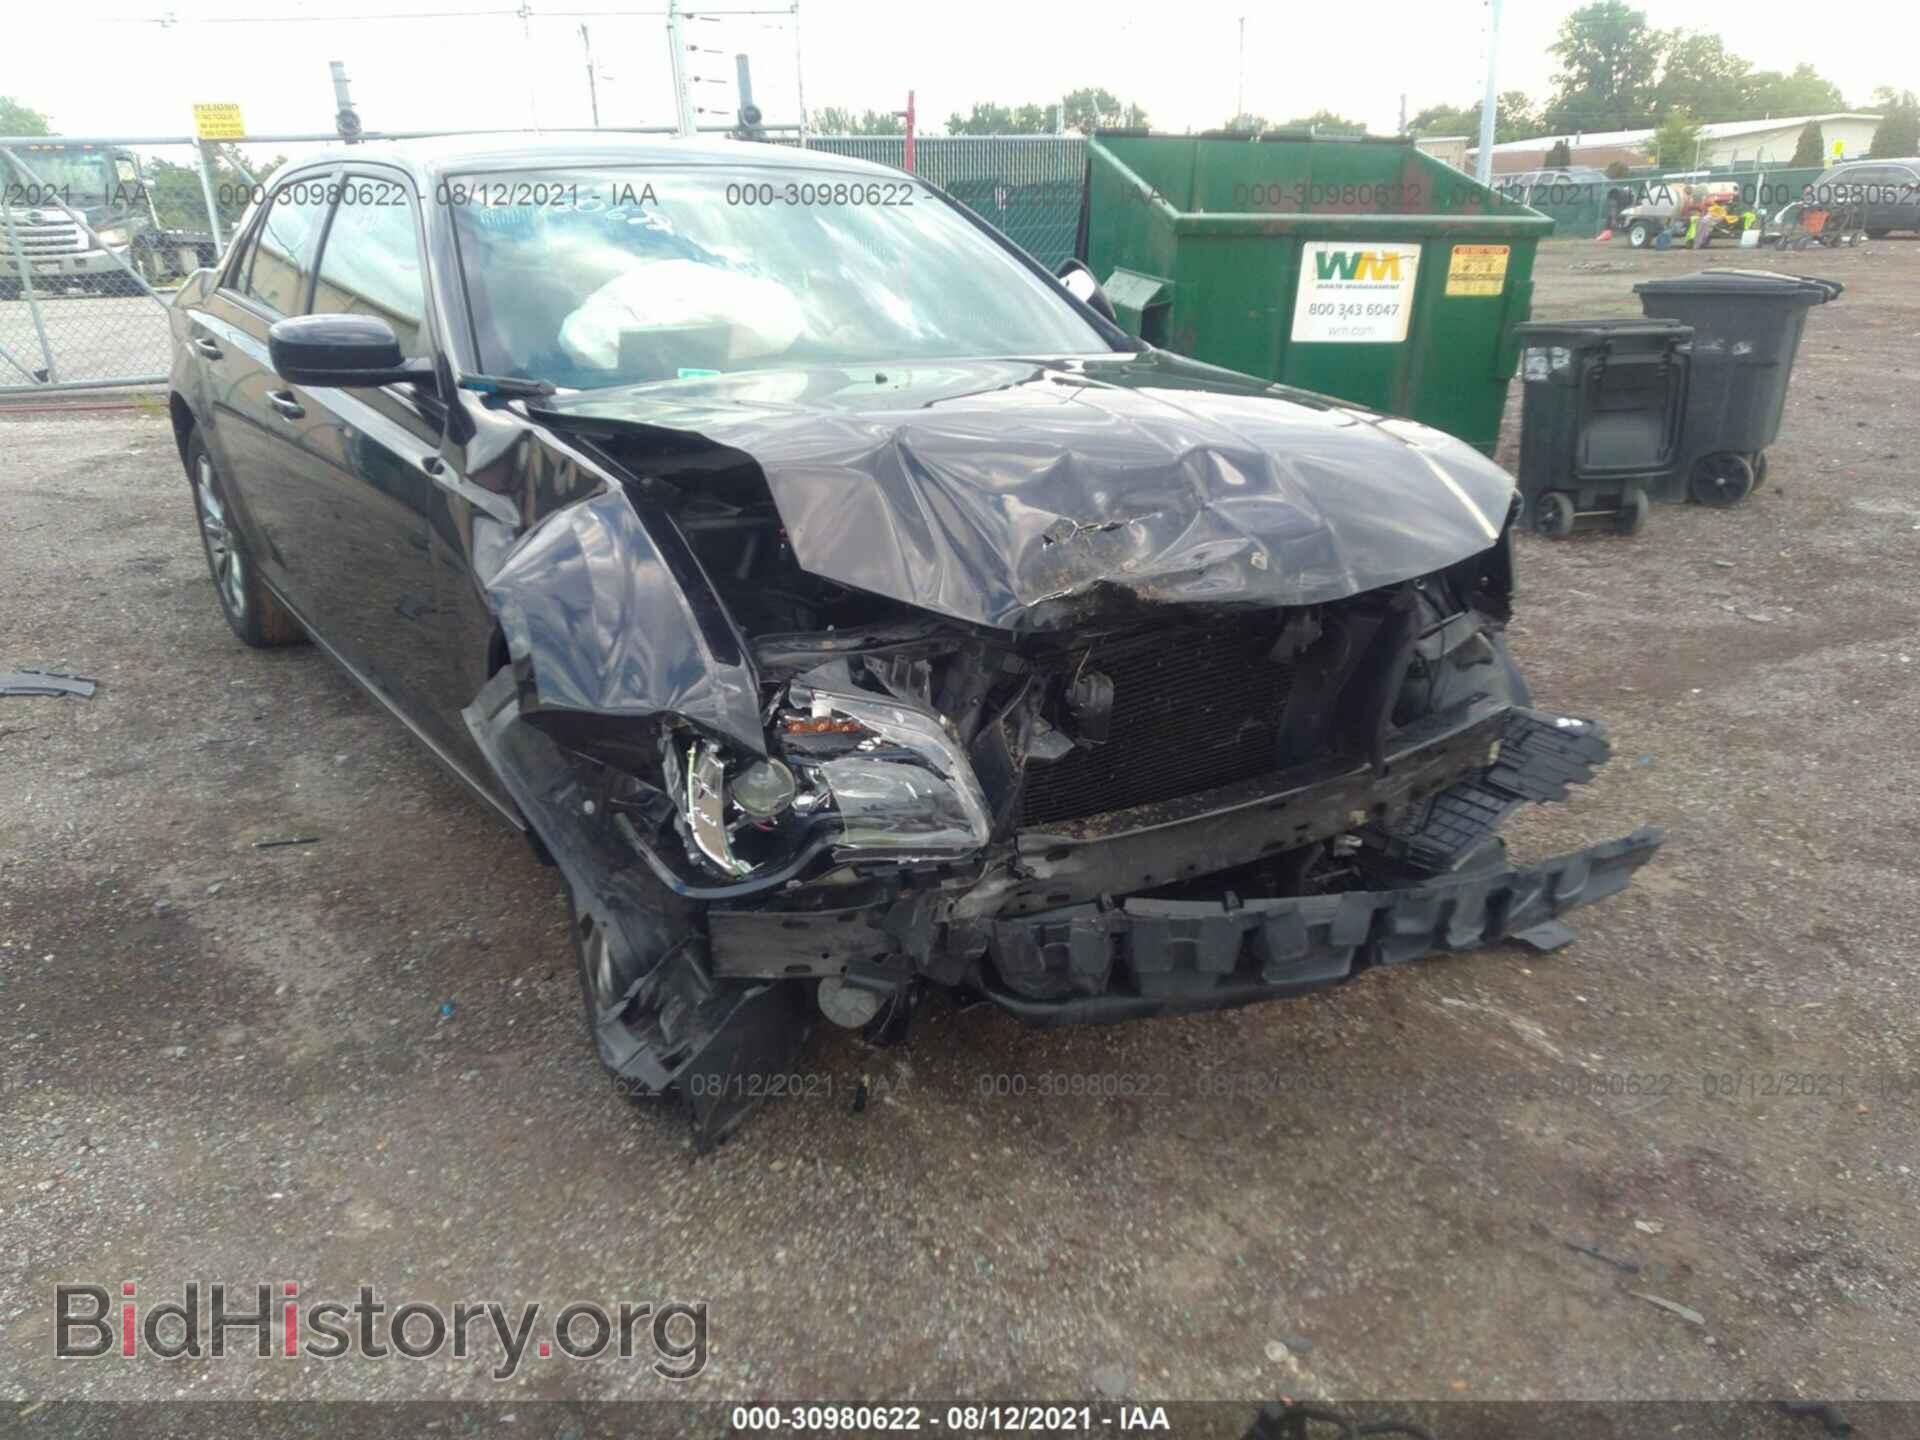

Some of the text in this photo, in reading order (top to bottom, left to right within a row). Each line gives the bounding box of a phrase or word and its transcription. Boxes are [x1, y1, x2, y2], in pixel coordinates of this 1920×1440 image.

[1315, 250, 1401, 281] WM
[1308, 303, 1400, 317] 800 343 6047
